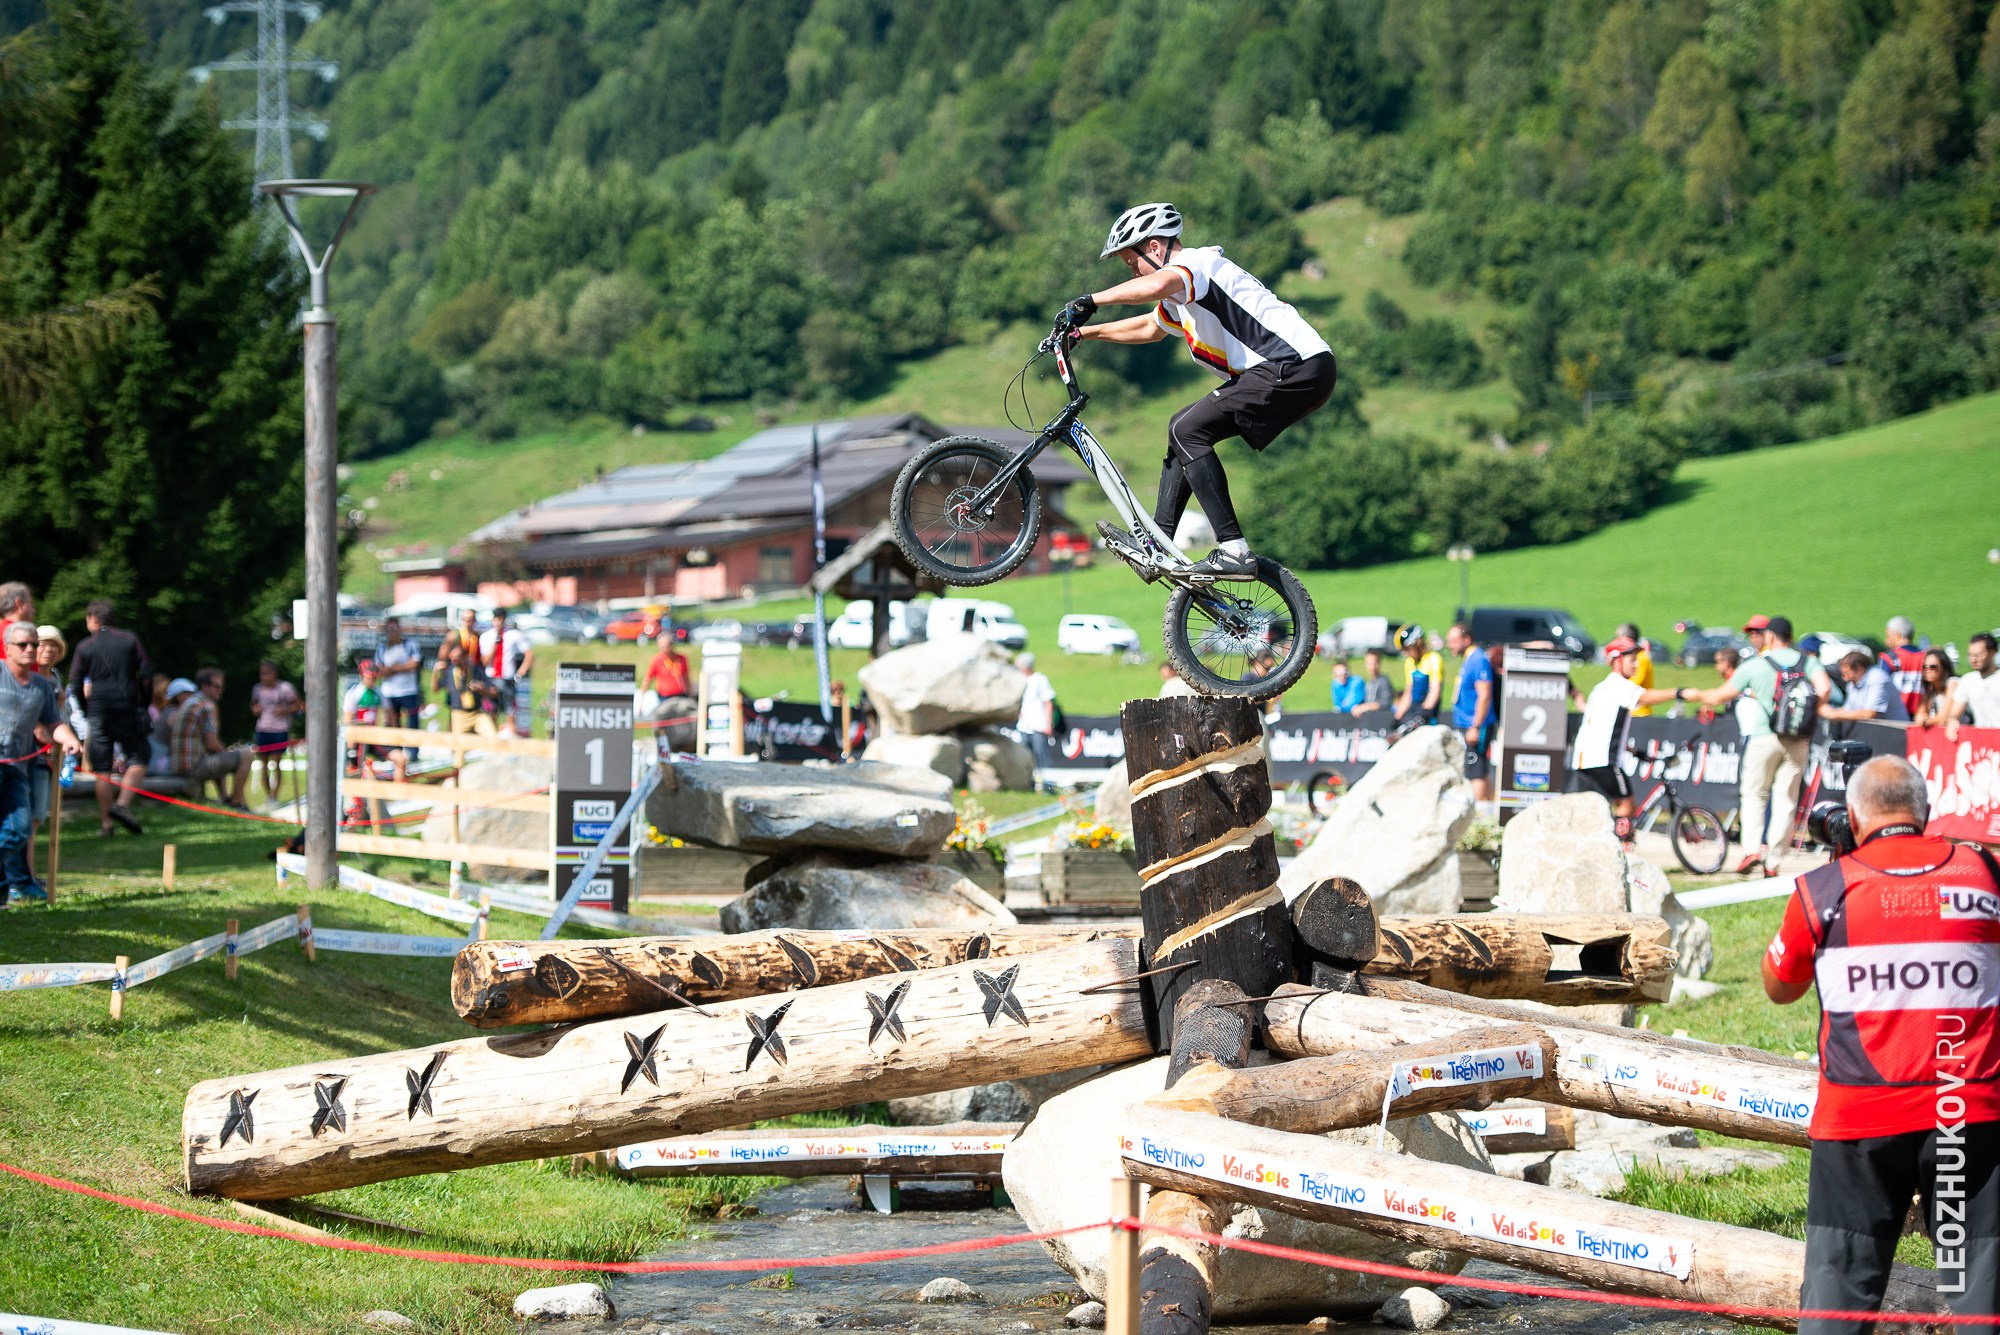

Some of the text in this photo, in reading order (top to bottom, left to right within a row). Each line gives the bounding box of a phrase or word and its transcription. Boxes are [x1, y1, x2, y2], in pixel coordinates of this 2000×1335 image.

[1506, 680, 1567, 701] FINISH
[560, 707, 632, 730] FINISH
[1520, 704, 1548, 745] 2
[585, 737, 605, 786] 1
[584, 805, 609, 817] UCI
[1881, 826, 1915, 837] Canon
[1847, 960, 1979, 993] PHOTO
[1447, 1057, 1505, 1082] TRENTINO
[1739, 1088, 1810, 1120] TRENTINO
[731, 1145, 790, 1161] TRENTINO
[1141, 1137, 1205, 1170] TRENTINO
[1299, 1173, 1366, 1204] TRENTINO
[1576, 1229, 1649, 1262] TRENTINO
